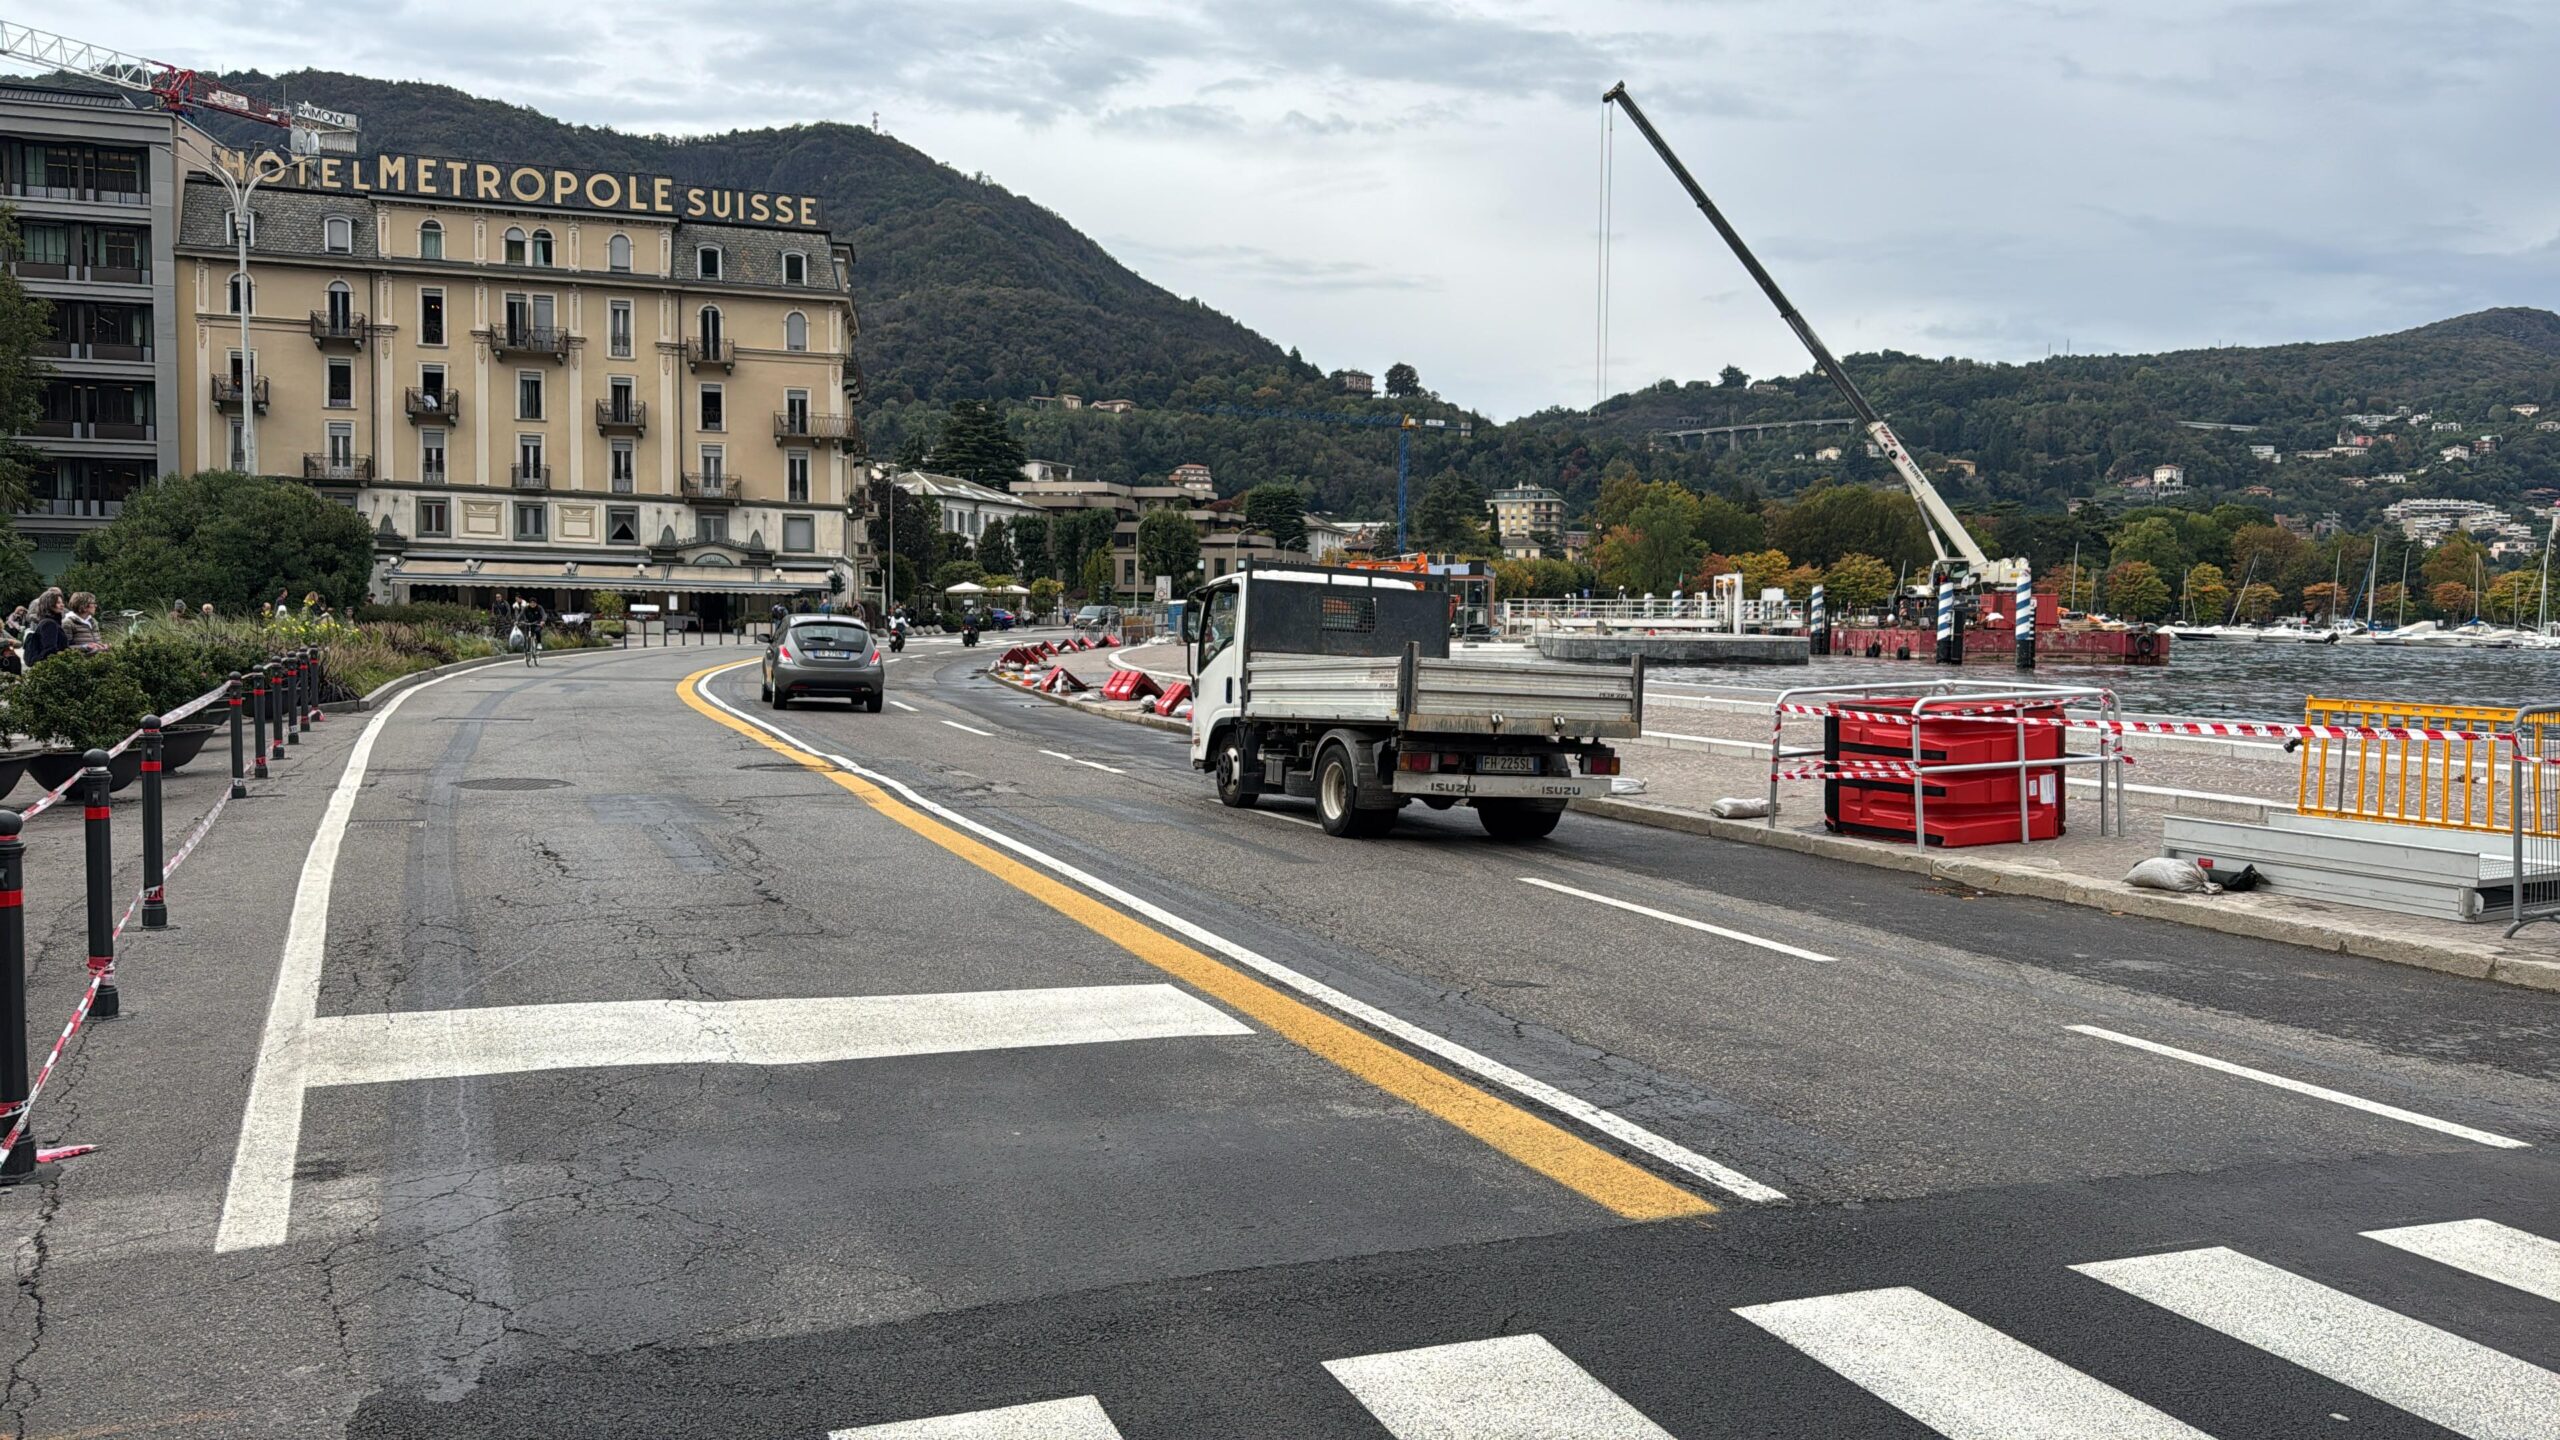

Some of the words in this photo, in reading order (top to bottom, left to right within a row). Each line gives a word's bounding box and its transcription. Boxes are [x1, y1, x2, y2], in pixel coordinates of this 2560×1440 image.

[222, 149, 371, 190] HOTEL
[379, 155, 674, 212] METROPOLE
[687, 188, 817, 226] SUISSE
[1907, 460, 1926, 485] TEREX
[1484, 755, 1497, 769] FH
[1500, 756, 1532, 770] 225SL
[1431, 782, 1476, 793] ISUZU
[1542, 786, 1581, 795] ISUZU
